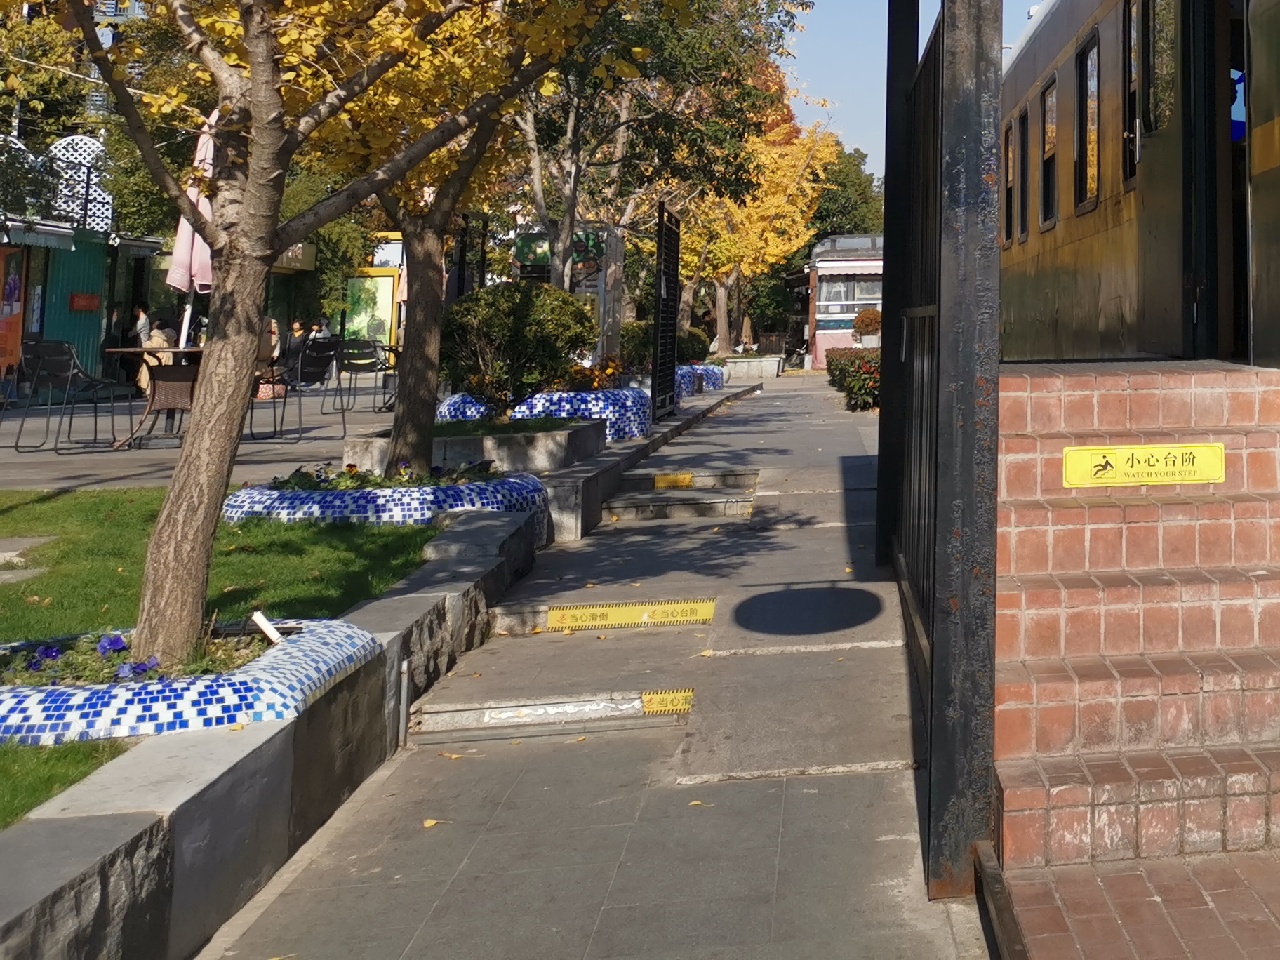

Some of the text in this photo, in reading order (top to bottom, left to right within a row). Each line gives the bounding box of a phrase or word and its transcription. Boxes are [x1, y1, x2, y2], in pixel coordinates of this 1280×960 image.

[1124, 451, 1197, 469] 小心台阶
[1154, 470, 1176, 478] YOUR
